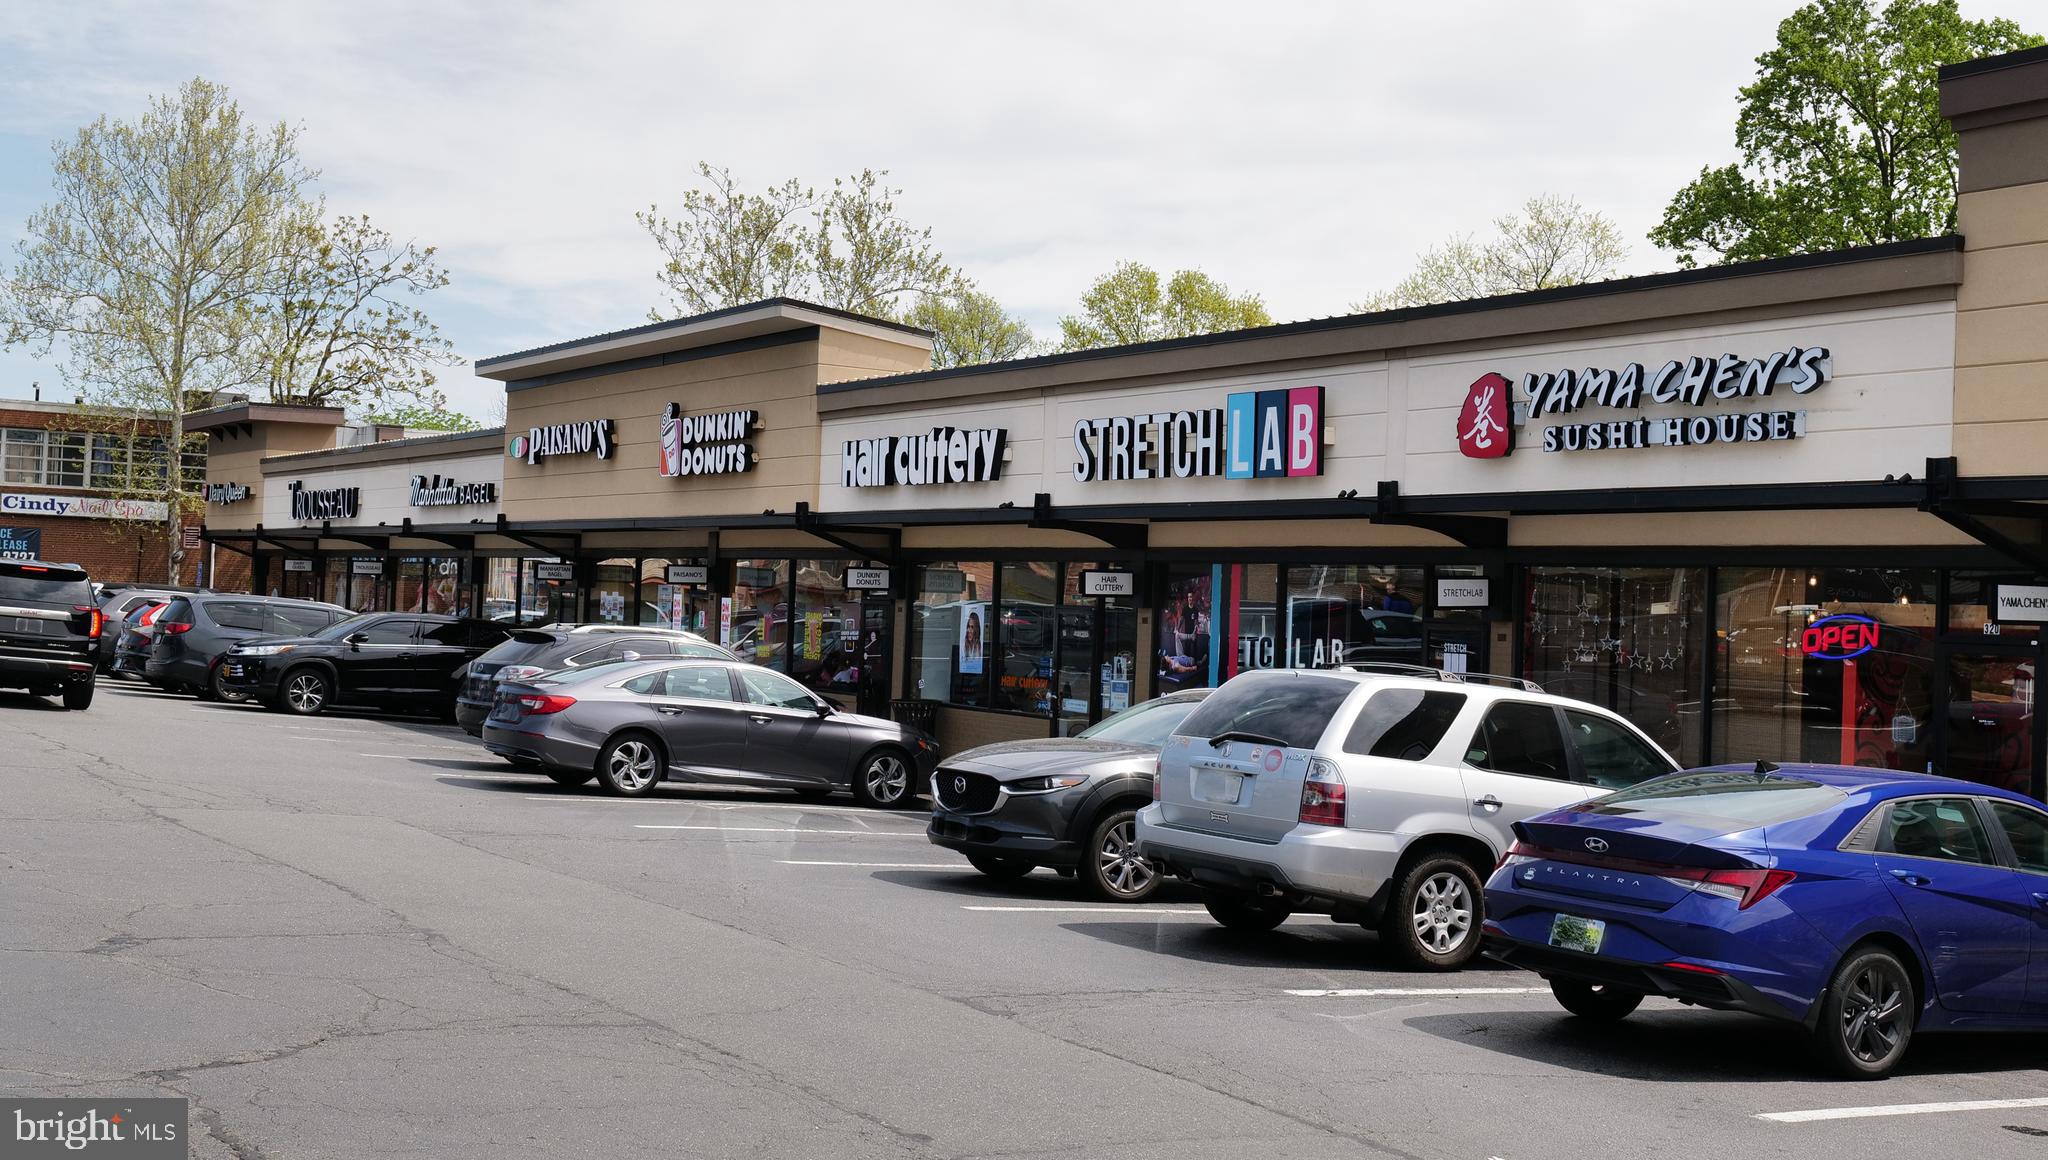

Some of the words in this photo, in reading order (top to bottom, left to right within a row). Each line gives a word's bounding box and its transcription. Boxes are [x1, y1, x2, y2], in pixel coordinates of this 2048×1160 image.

[1523, 361, 1644, 418] YAMA
[1651, 346, 1831, 407] CHEN'S
[682, 411, 758, 445] DUNKIN'
[1543, 420, 1651, 453] SUSHI
[1662, 411, 1797, 446] HOUSE
[527, 418, 615, 466] PAISANO'S
[1073, 408, 1224, 483] STRETCH
[1230, 400, 1316, 475] LAB
[681, 443, 752, 476] DONUTS
[841, 440, 892, 488] Hair
[895, 427, 1008, 486] cuttery
[225, 482, 250, 505] Queen
[288, 480, 360, 521] TROUSSEAU
[409, 474, 460, 507] Manhattan
[459, 482, 494, 505] BAGEL
[2, 495, 70, 515] Cindy
[69, 499, 109, 515] Nail
[114, 500, 145, 518] Spa
[855, 578, 881, 587] DONUTS
[856, 571, 882, 579] DUNKIN'
[1101, 575, 1118, 584] HAIR
[1094, 583, 1124, 592] CUTTERY
[1443, 587, 1484, 599] STRETCHLAB
[1802, 622, 1880, 654] OPEN
[1984, 623, 1999, 635] 320
[1443, 642, 1468, 654] STRETCH
[1203, 762, 1240, 770] ACURA
[1546, 866, 1640, 886] ELANTRA
